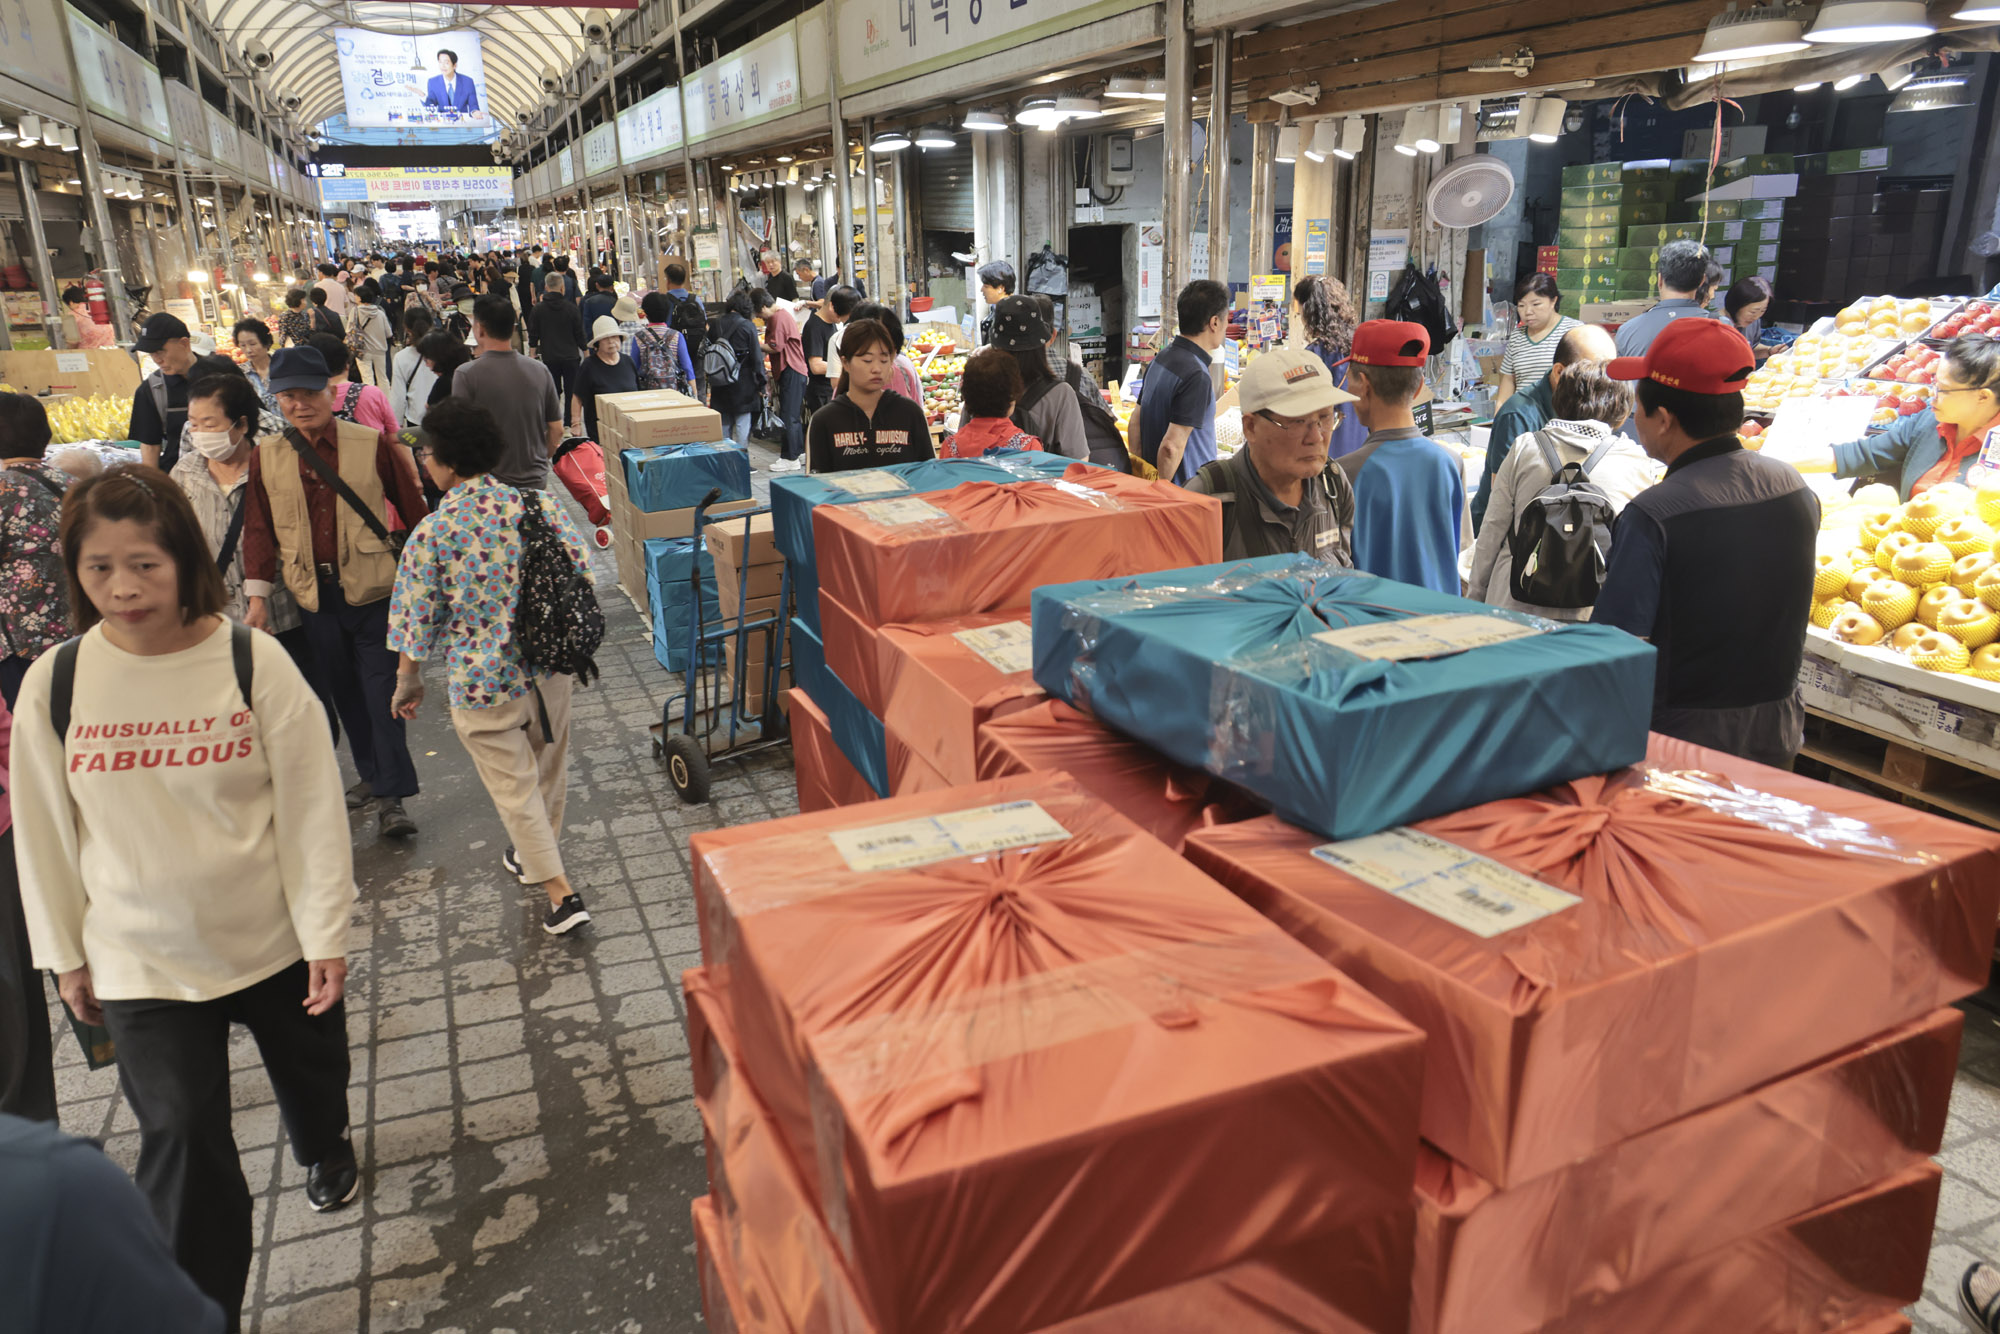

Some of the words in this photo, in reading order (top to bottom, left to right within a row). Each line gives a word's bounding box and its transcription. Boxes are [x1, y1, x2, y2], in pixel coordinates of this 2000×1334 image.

[708, 62, 760, 120] 동광상회
[1280, 216, 1290, 226] My
[833, 431, 868, 448] HARLEY-
[875, 429, 909, 446] DAVIDSON
[843, 444, 869, 456] Motor
[876, 443, 902, 456] cycles
[70, 737, 253, 773] FABULOUS
